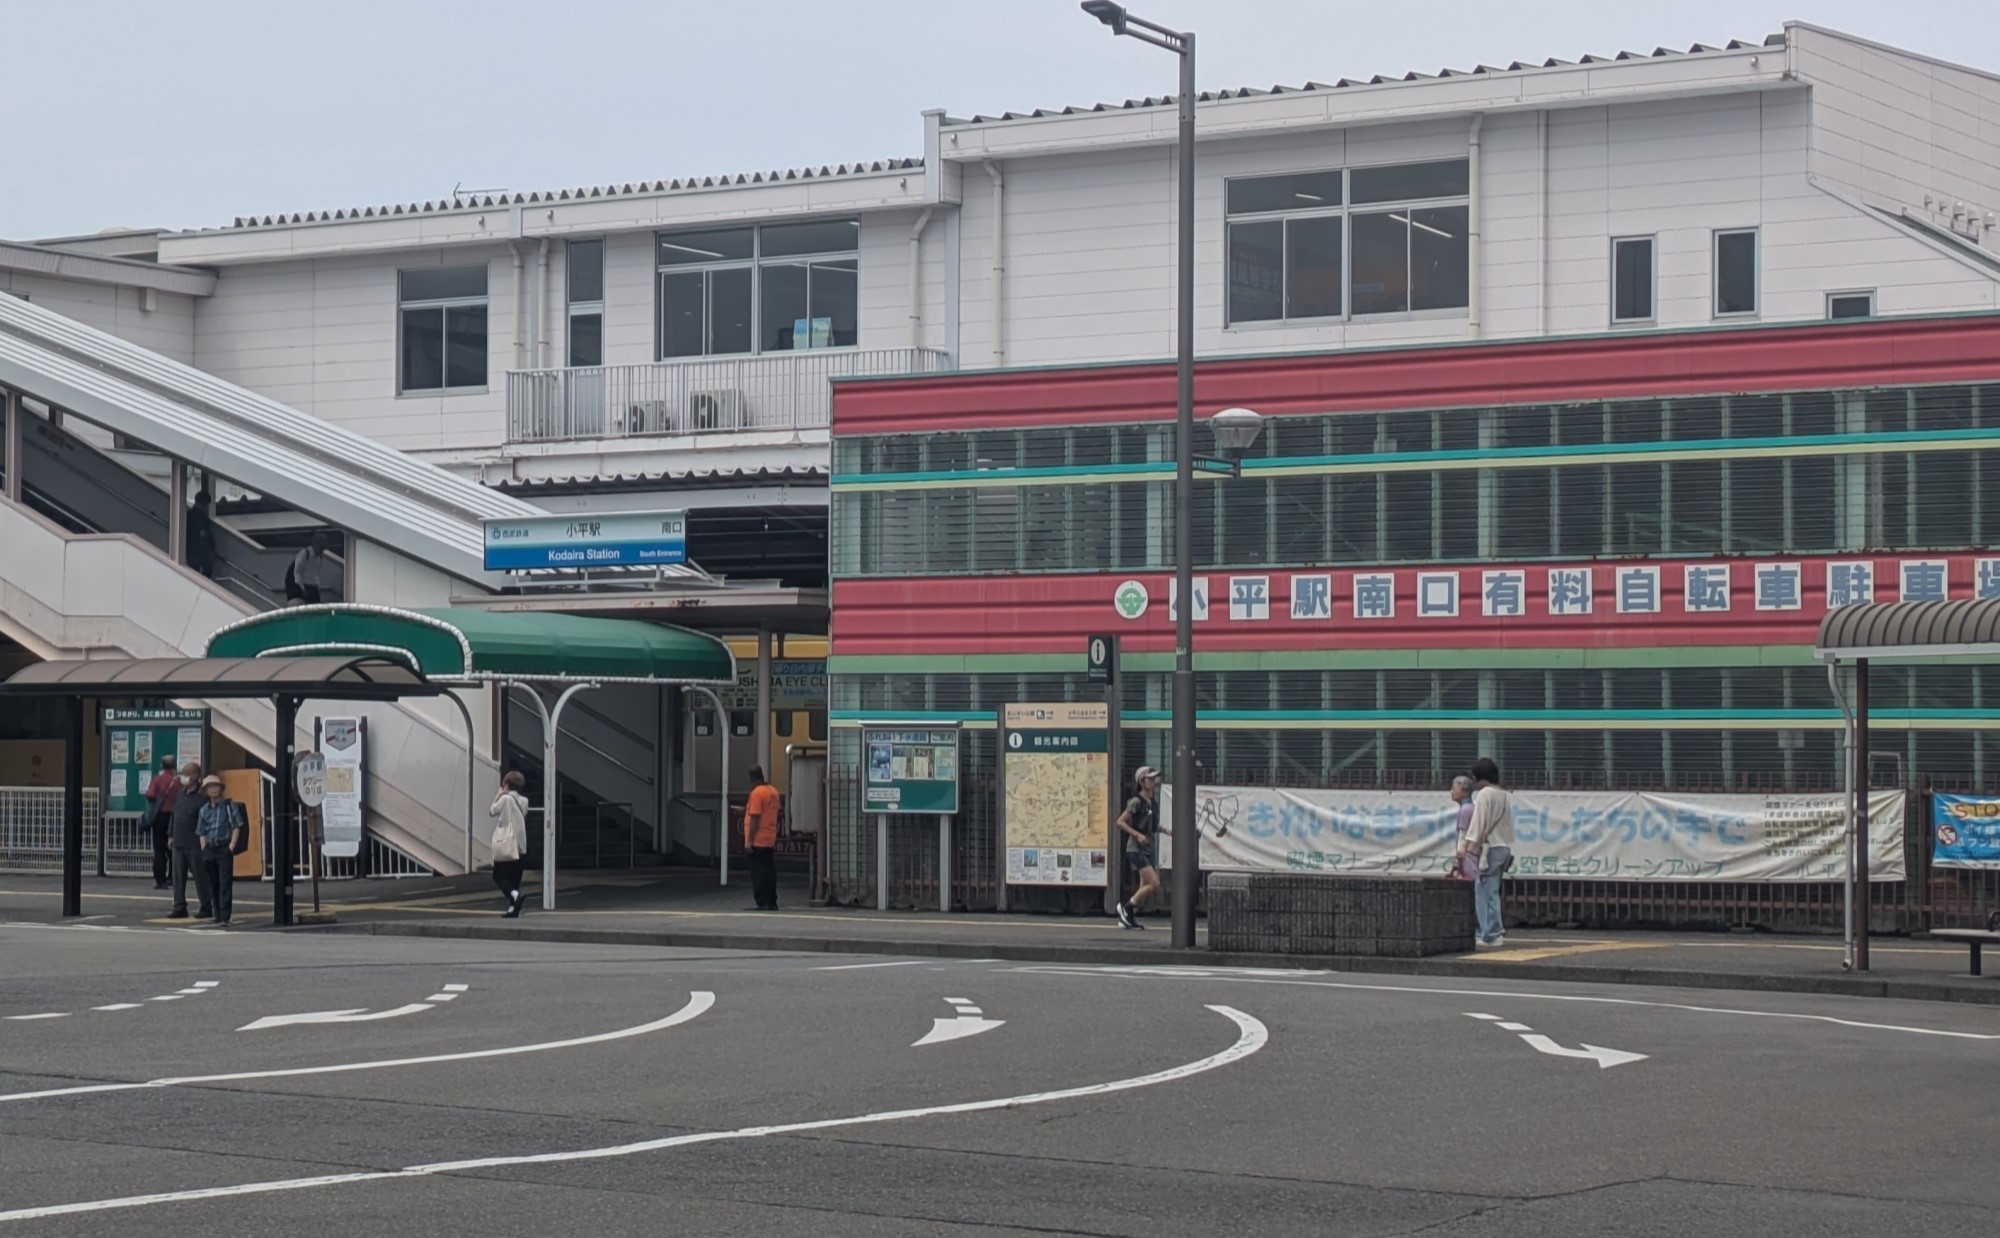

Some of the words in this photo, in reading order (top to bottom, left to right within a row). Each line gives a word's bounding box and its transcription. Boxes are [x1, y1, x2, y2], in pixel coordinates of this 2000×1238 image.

[566, 522, 601, 538] 小平駅
[661, 521, 682, 535] 南口
[548, 549, 585, 561] Kodaira
[586, 548, 620, 560] Station
[785, 677, 808, 687] EYE
[810, 676, 828, 687] CL
[1034, 735, 1079, 747] 観光案内図
[302, 776, 323, 787] タクシー
